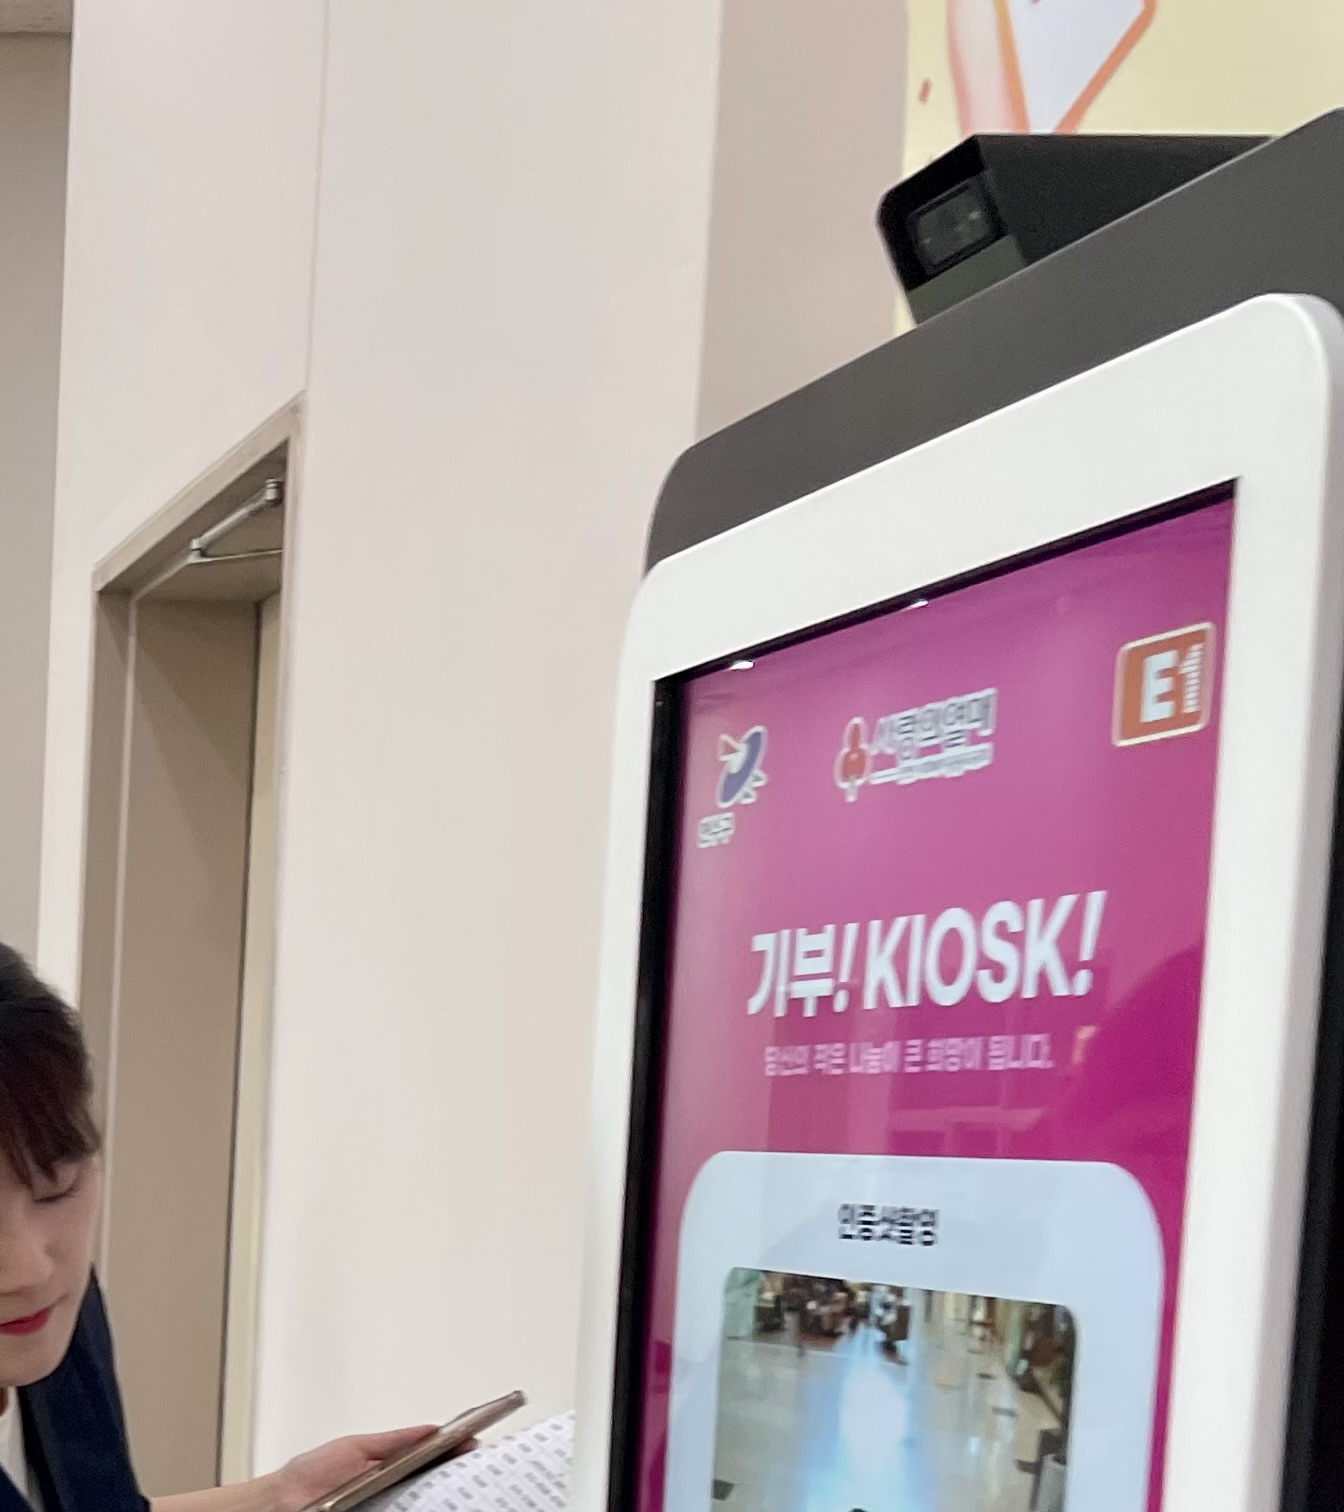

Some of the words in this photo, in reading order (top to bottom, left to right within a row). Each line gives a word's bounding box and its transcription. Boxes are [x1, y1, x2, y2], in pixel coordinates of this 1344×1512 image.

[1140, 642, 1204, 723] E1
[746, 922, 860, 1018] 기부!
[862, 889, 1109, 1010] KIOSK!
